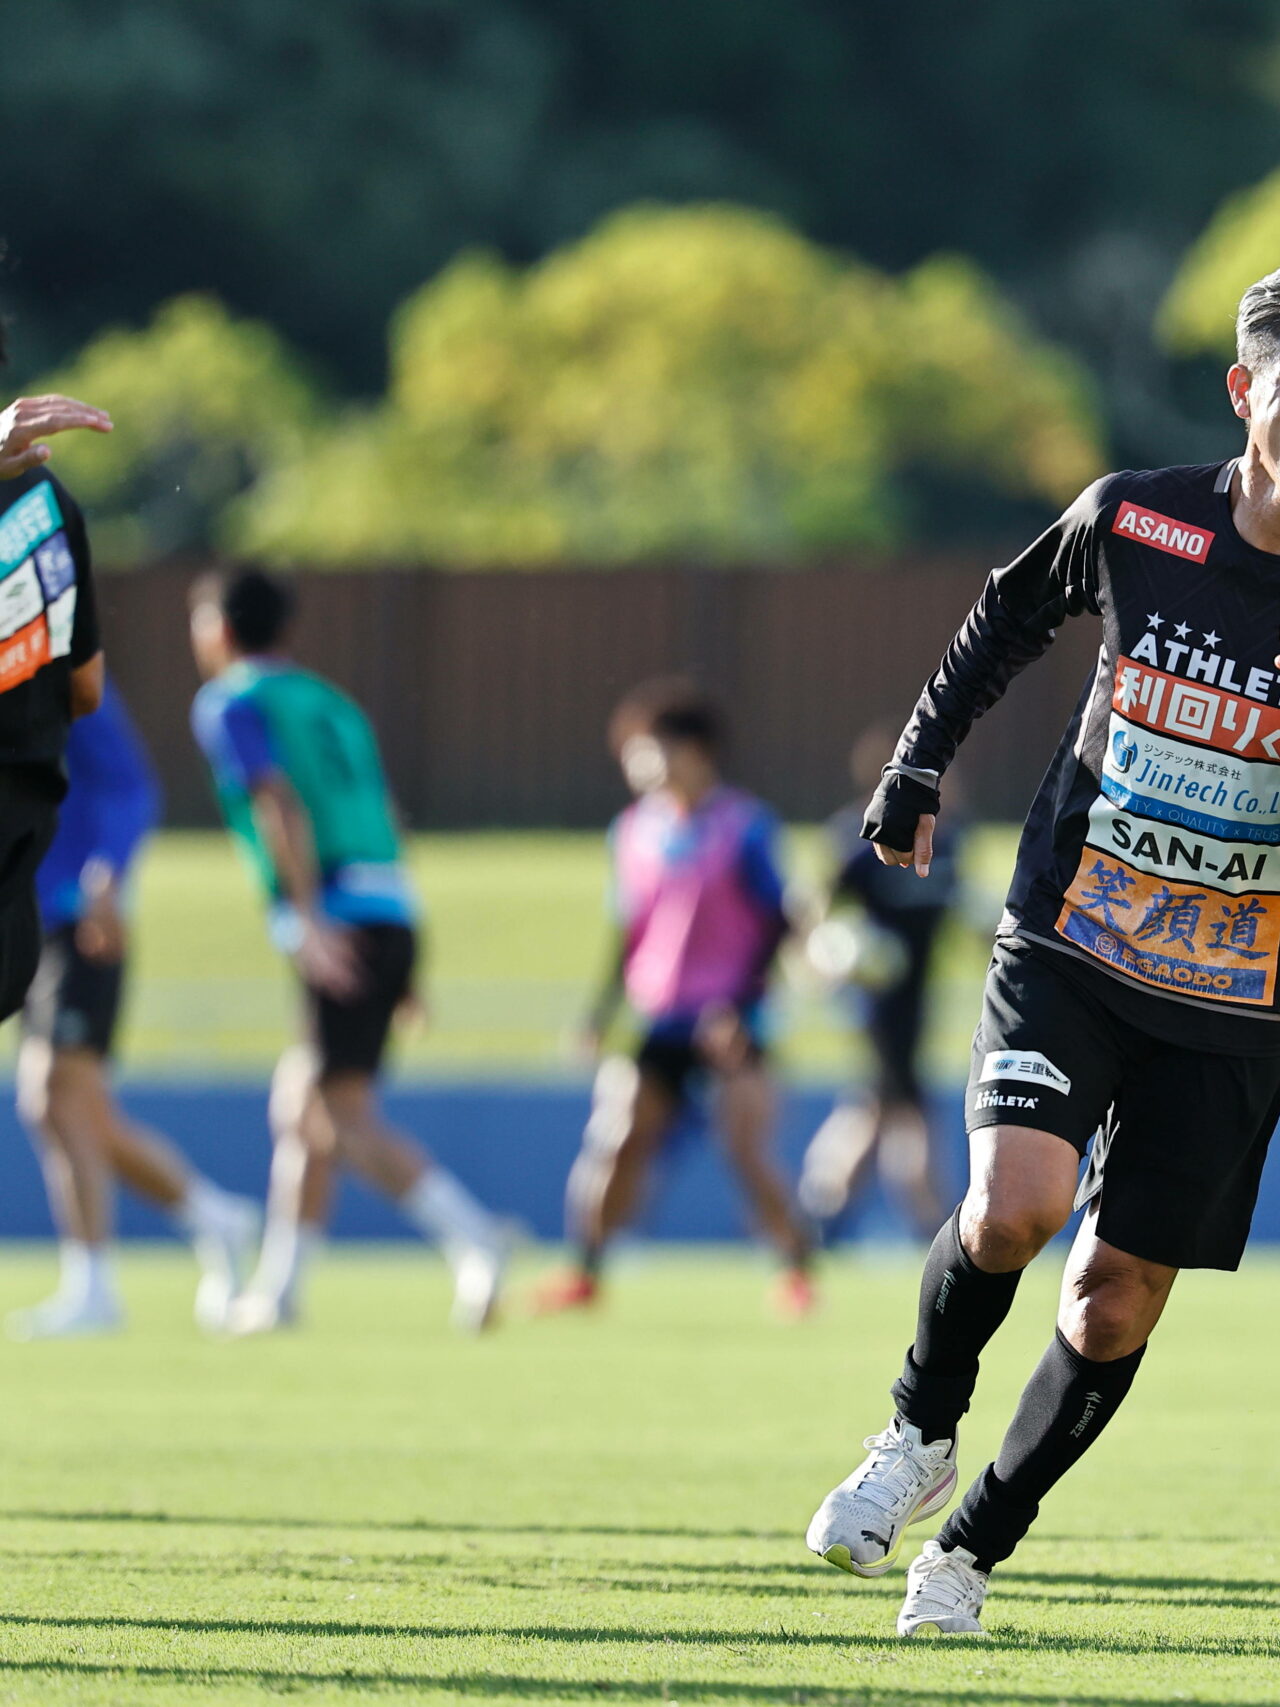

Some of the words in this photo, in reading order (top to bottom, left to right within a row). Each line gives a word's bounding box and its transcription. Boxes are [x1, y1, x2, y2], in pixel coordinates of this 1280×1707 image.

[1117, 510, 1205, 556] ASANO
[1135, 758, 1225, 807] Jintech
[1144, 743, 1242, 781] ジンテック株式会社
[1168, 809, 1229, 834] QUALITY
[1112, 818, 1267, 881] SAN-AI
[1077, 859, 1270, 960] 笑顔道
[1121, 949, 1233, 989] EGAODO
[974, 1095, 1036, 1111] ATHLETA
